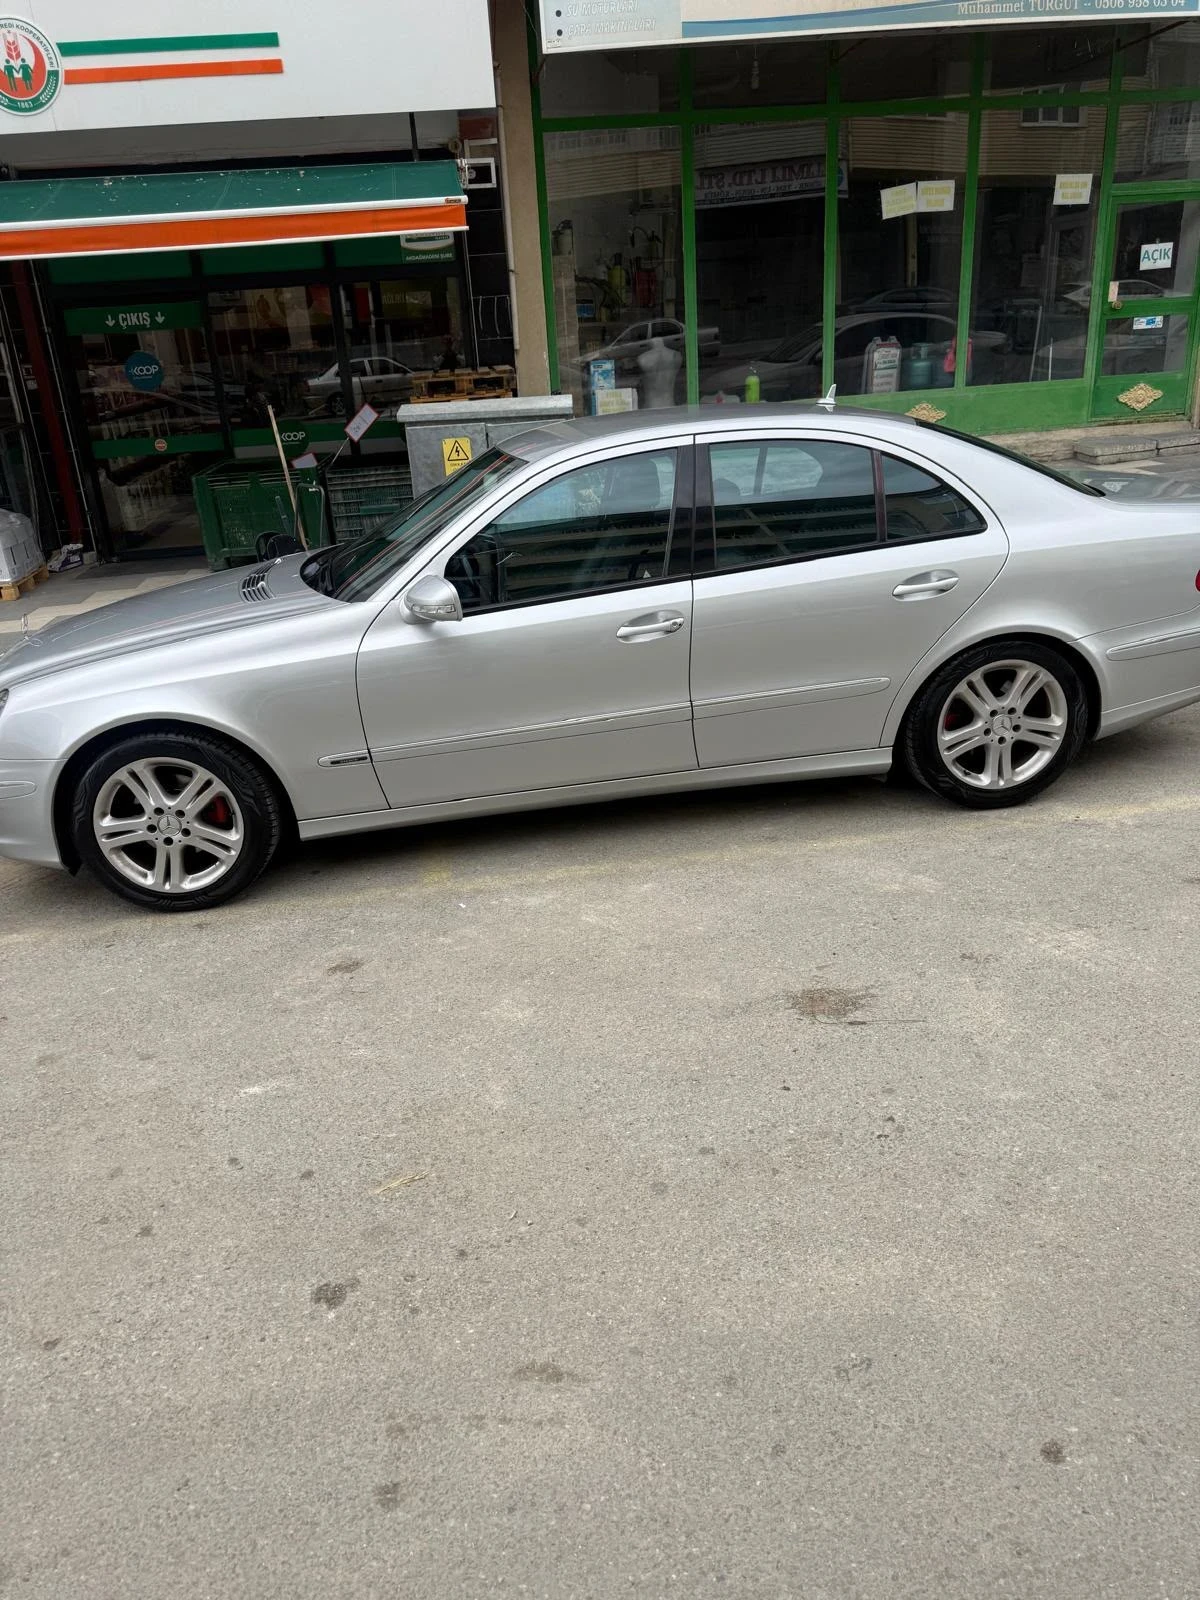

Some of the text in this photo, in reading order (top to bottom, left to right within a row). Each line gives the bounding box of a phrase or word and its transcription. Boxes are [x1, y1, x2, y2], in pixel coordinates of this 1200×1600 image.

[958, 1, 1025, 15] Muhammet
[1029, 0, 1079, 11] TURGUT
[1142, 247, 1171, 263] AÇIK
[118, 311, 151, 329] ÇIKIŞ
[130, 364, 159, 376] KOOP
[280, 431, 306, 441] KOOP
